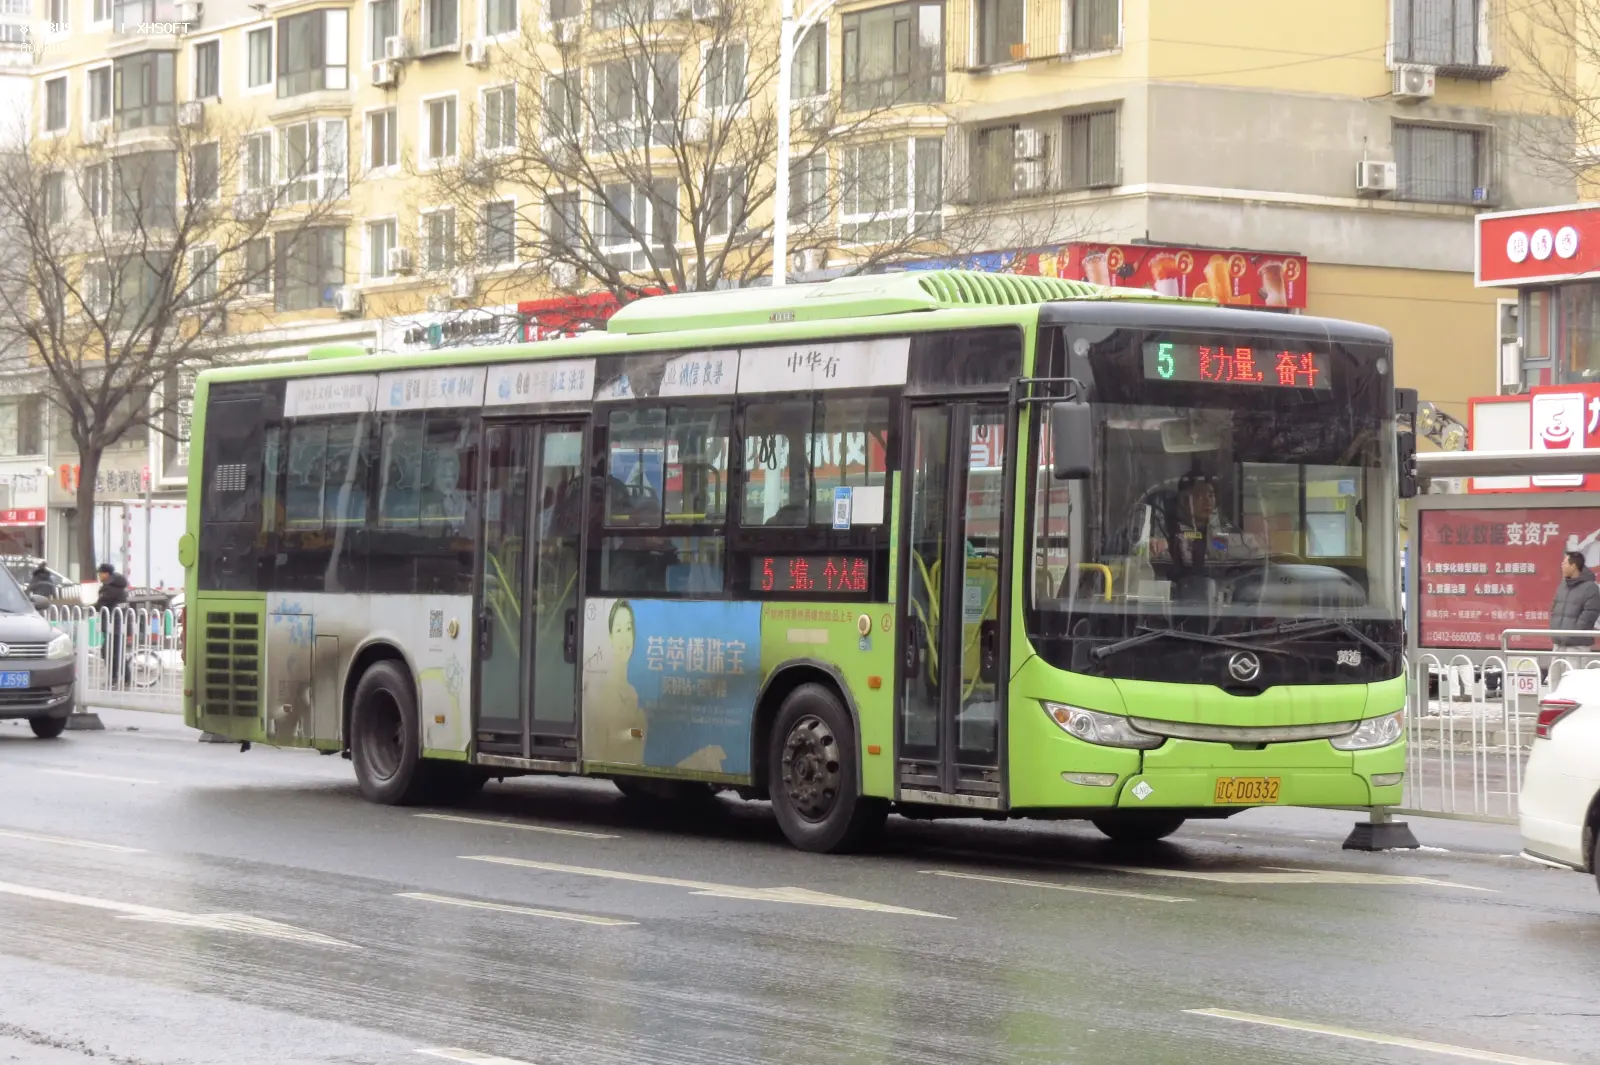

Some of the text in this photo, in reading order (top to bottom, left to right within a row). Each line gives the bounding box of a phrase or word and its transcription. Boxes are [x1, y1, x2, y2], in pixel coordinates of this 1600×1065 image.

[787, 351, 841, 378] 中华有
[1157, 343, 1174, 378] 5
[1439, 521, 1560, 546] 企业数据变资产
[763, 558, 775, 591] 5
[646, 635, 746, 675] 荟萃楼珠宝
